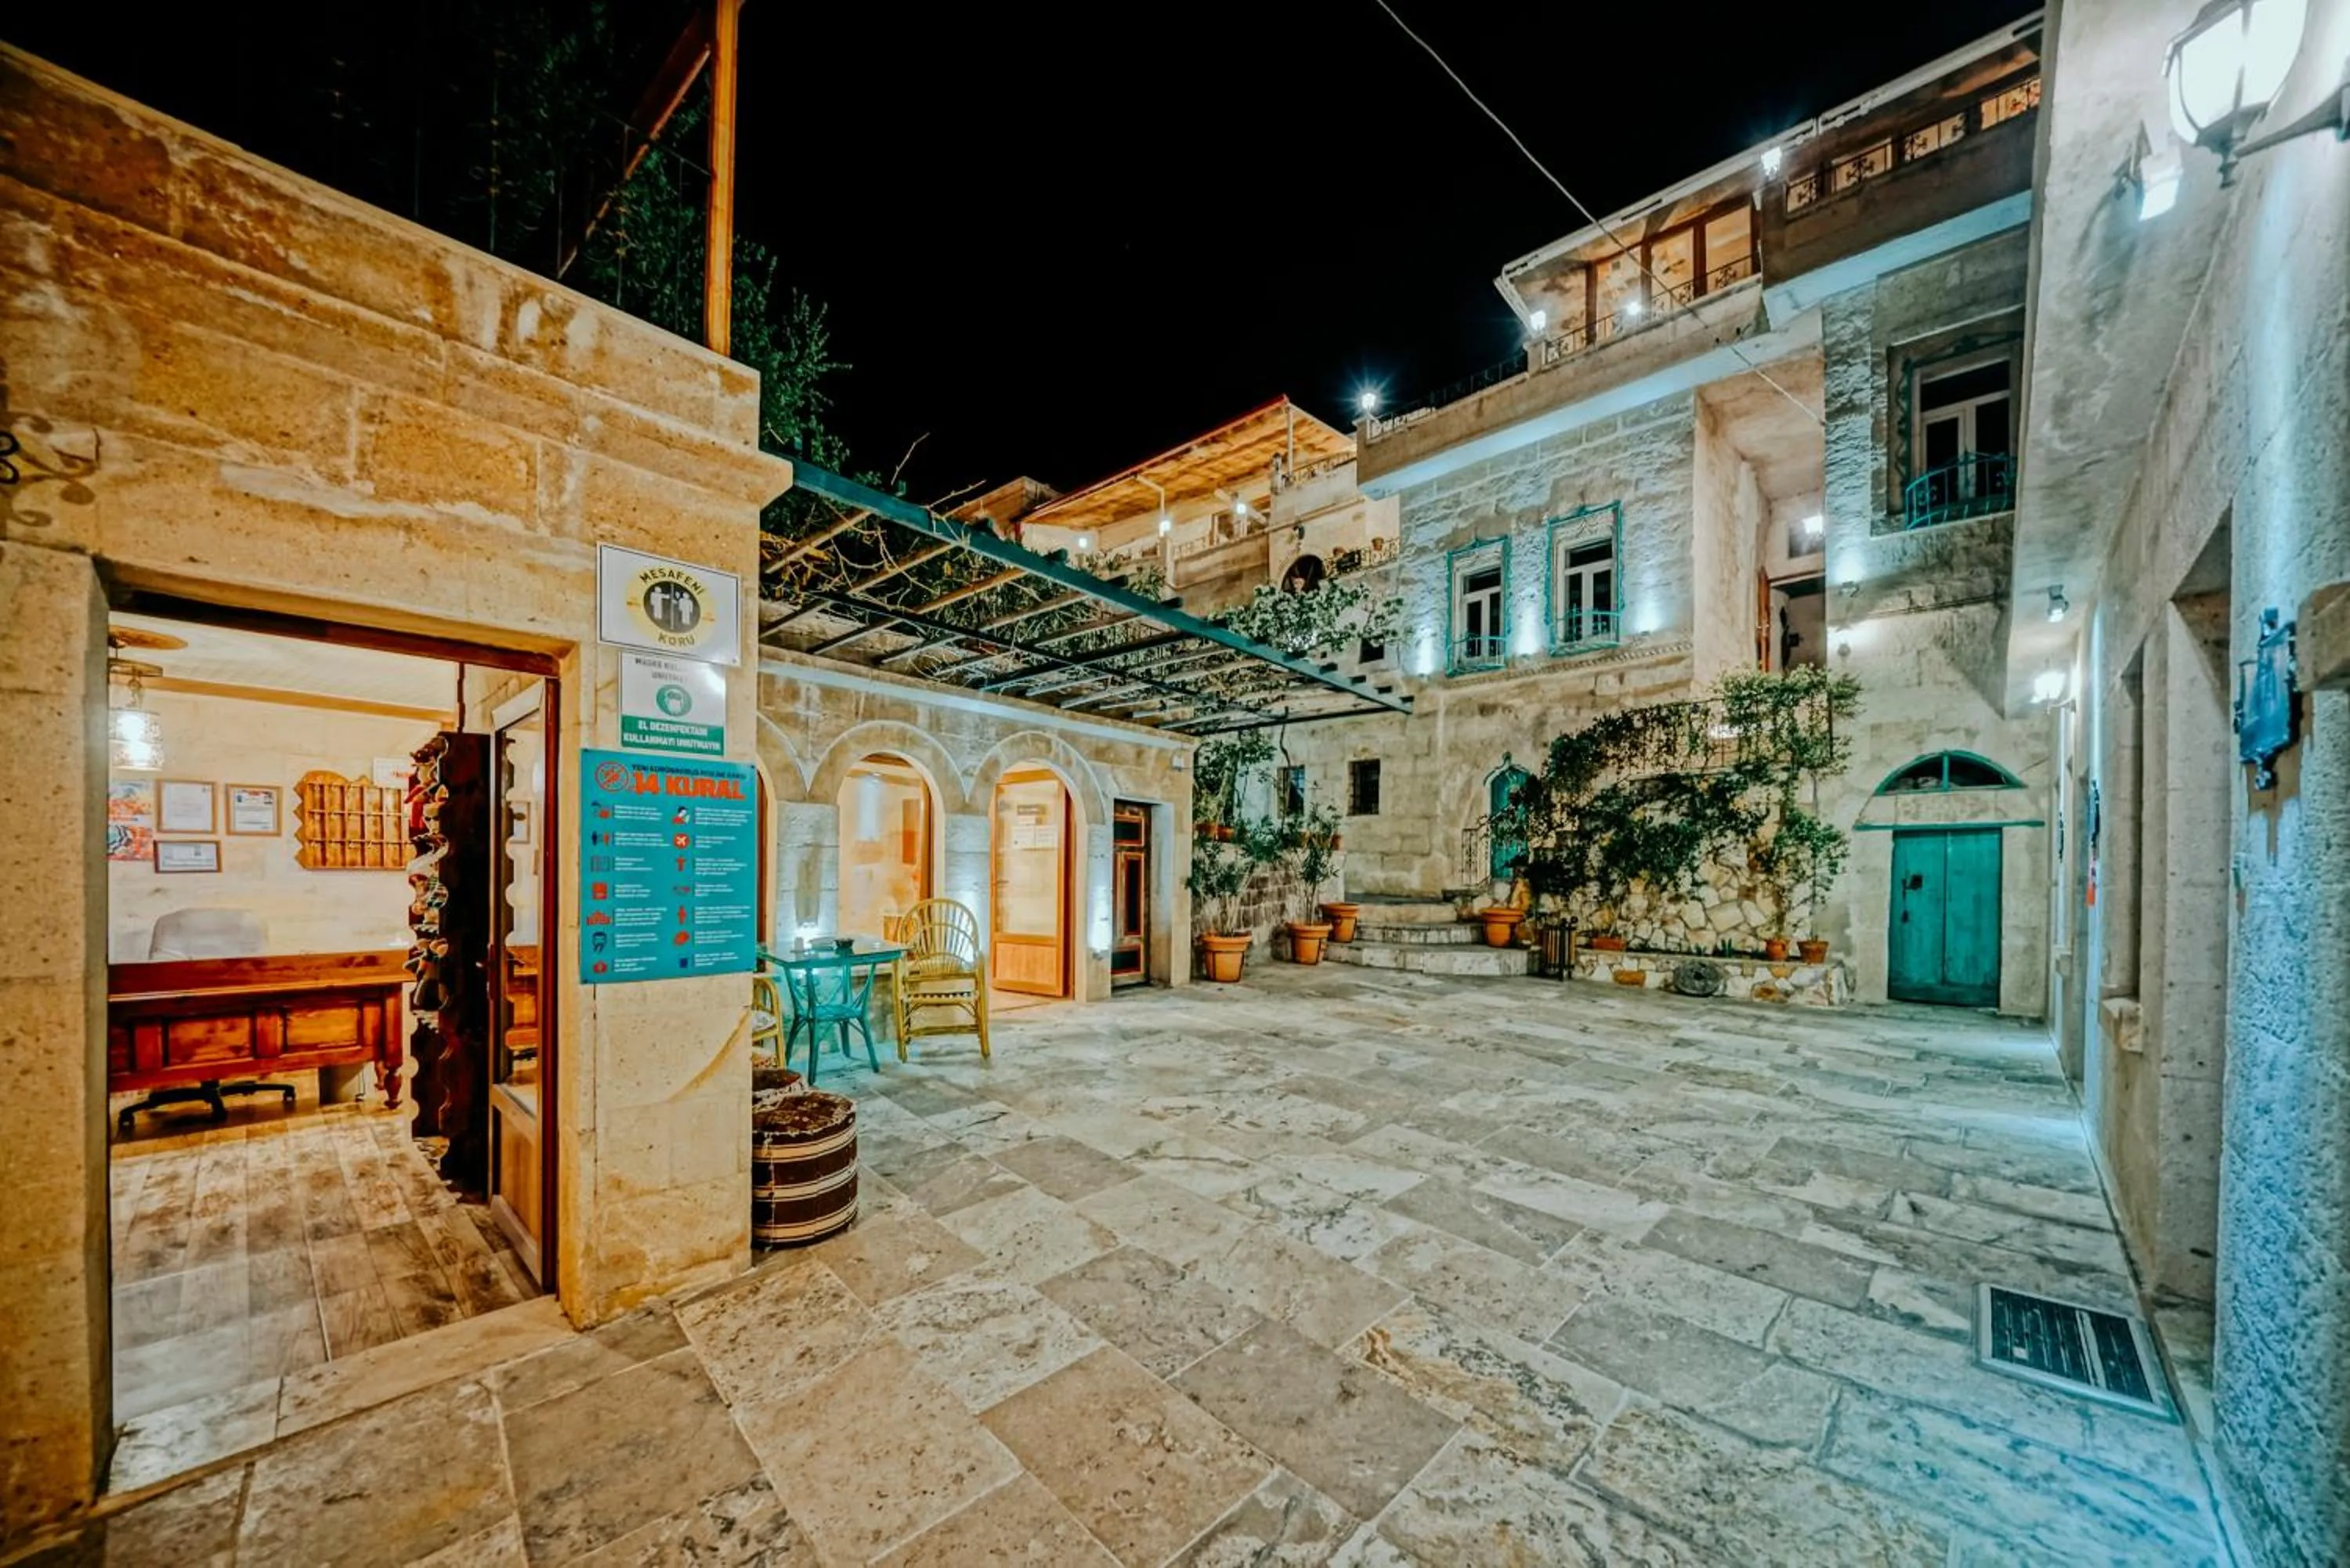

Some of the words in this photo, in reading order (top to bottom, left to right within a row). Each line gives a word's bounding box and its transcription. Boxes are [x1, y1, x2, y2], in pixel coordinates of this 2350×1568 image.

[658, 632, 695, 646] KORU
[633, 771, 660, 795] 14
[665, 775, 746, 800] KURAL
